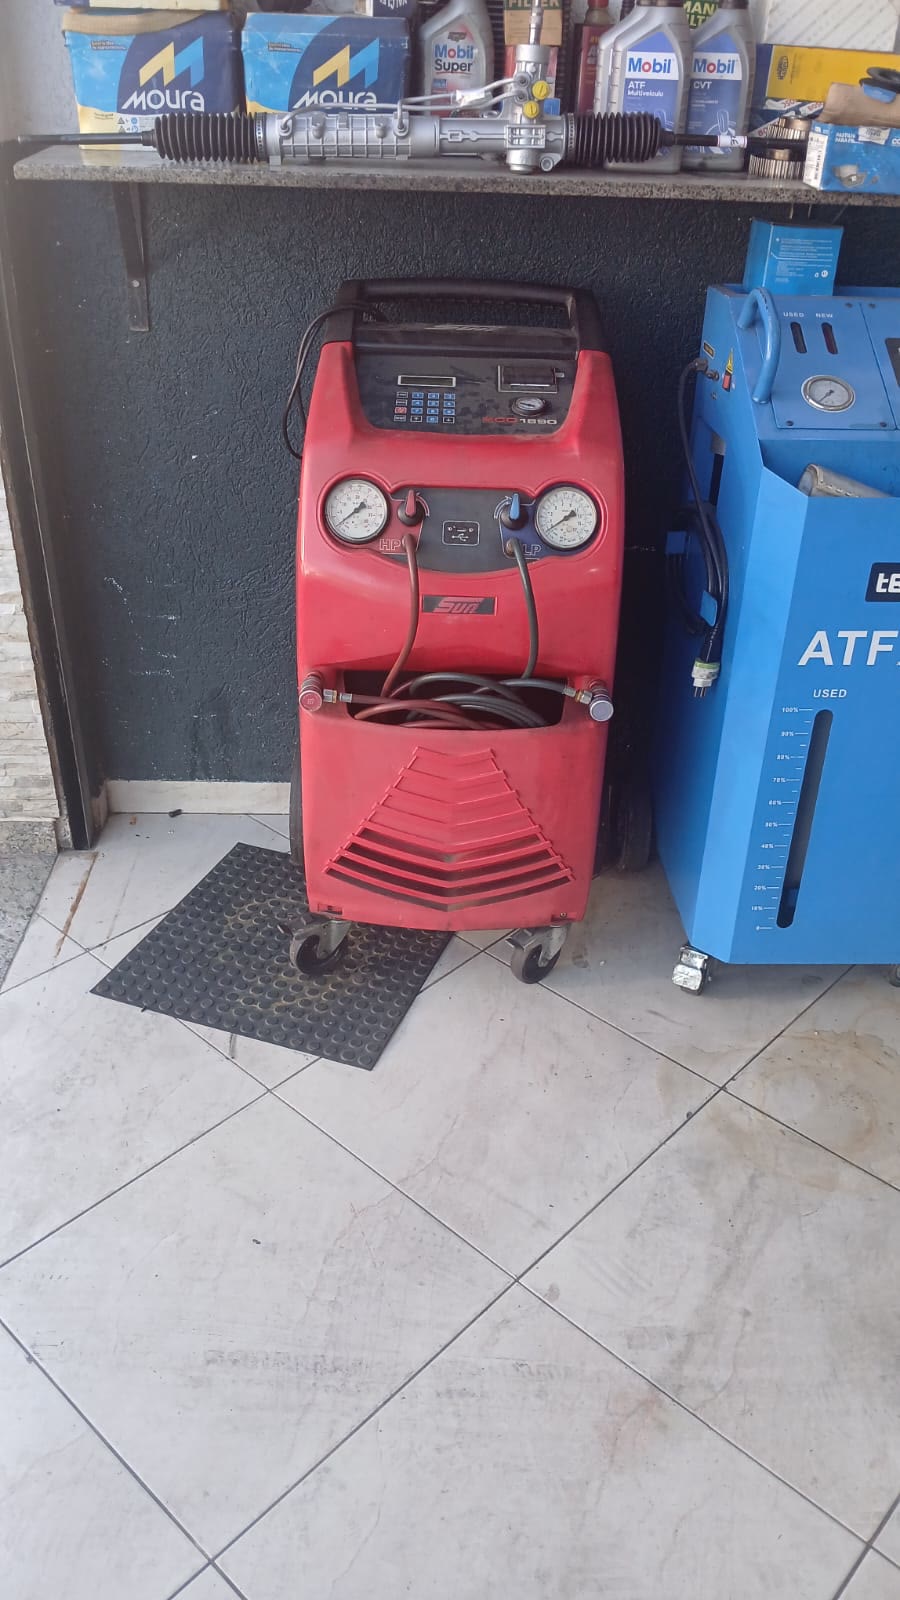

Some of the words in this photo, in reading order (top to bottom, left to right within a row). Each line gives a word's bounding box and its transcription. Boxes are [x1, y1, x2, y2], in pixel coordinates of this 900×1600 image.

[434, 43, 474, 59] Mobil
[434, 58, 472, 73] Super
[628, 57, 672, 74] Mobil
[693, 58, 736, 74] Mobil
[628, 81, 646, 89] ATF
[693, 82, 712, 90] CVT
[380, 539, 401, 550] HP
[524, 545, 541, 555] LP
[813, 688, 847, 698] USED
